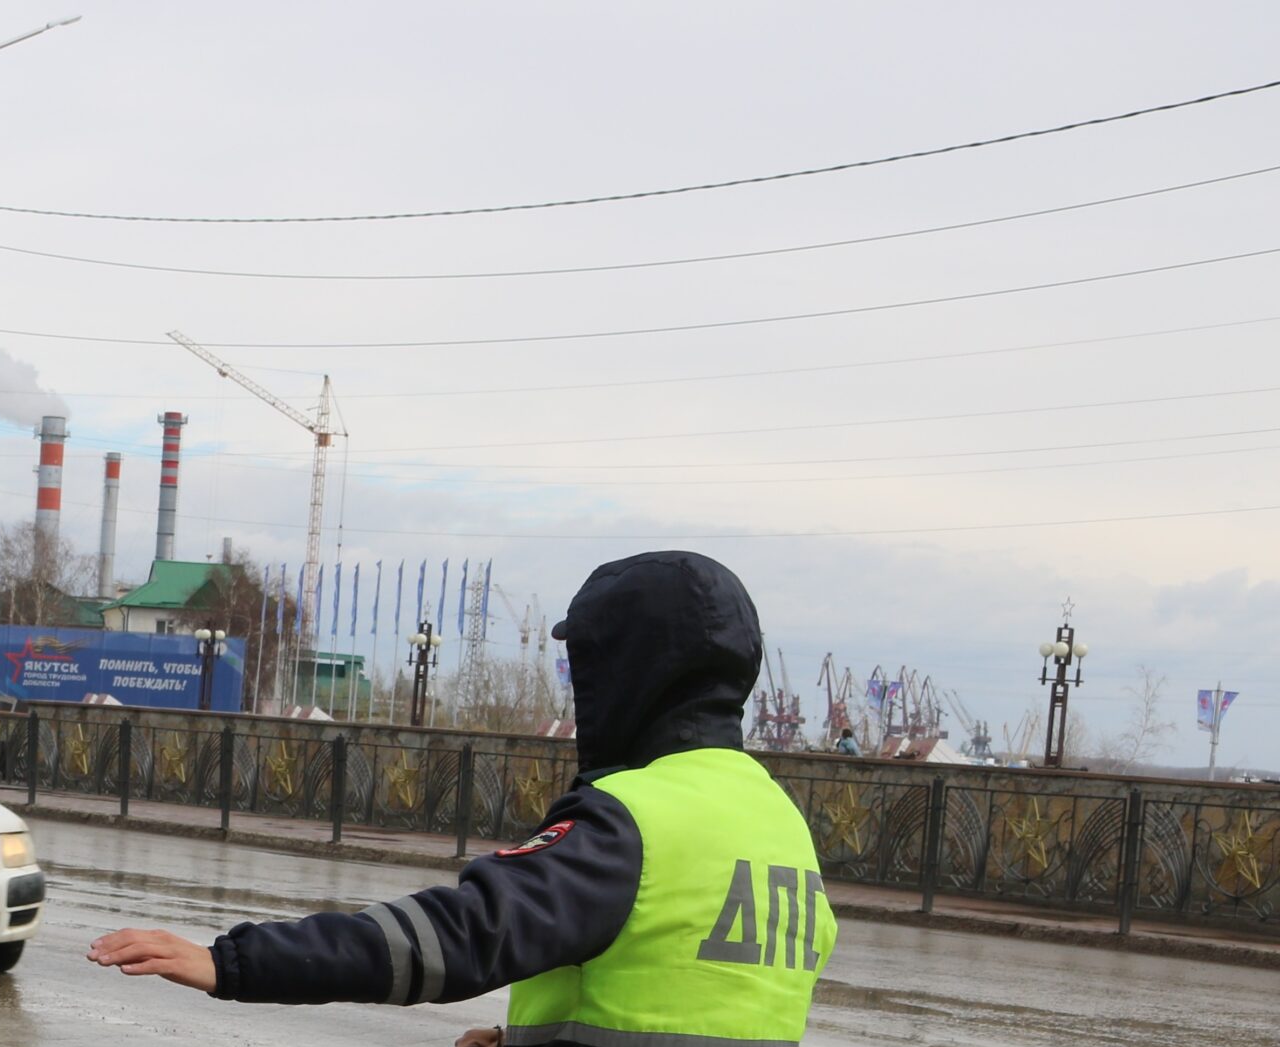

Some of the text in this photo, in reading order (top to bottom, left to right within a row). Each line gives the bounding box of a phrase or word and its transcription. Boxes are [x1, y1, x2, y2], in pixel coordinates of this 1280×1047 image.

[24, 661, 79, 673] ЯКУТСК
[99, 659, 202, 676] ПОМНИТЬ, ЧТОБЫ
[23, 672, 87, 681] ГОРОД ТРУДОВОЙ
[112, 676, 188, 691] ПОБЕЖДАТЬ!
[696, 859, 825, 972] ДПС
